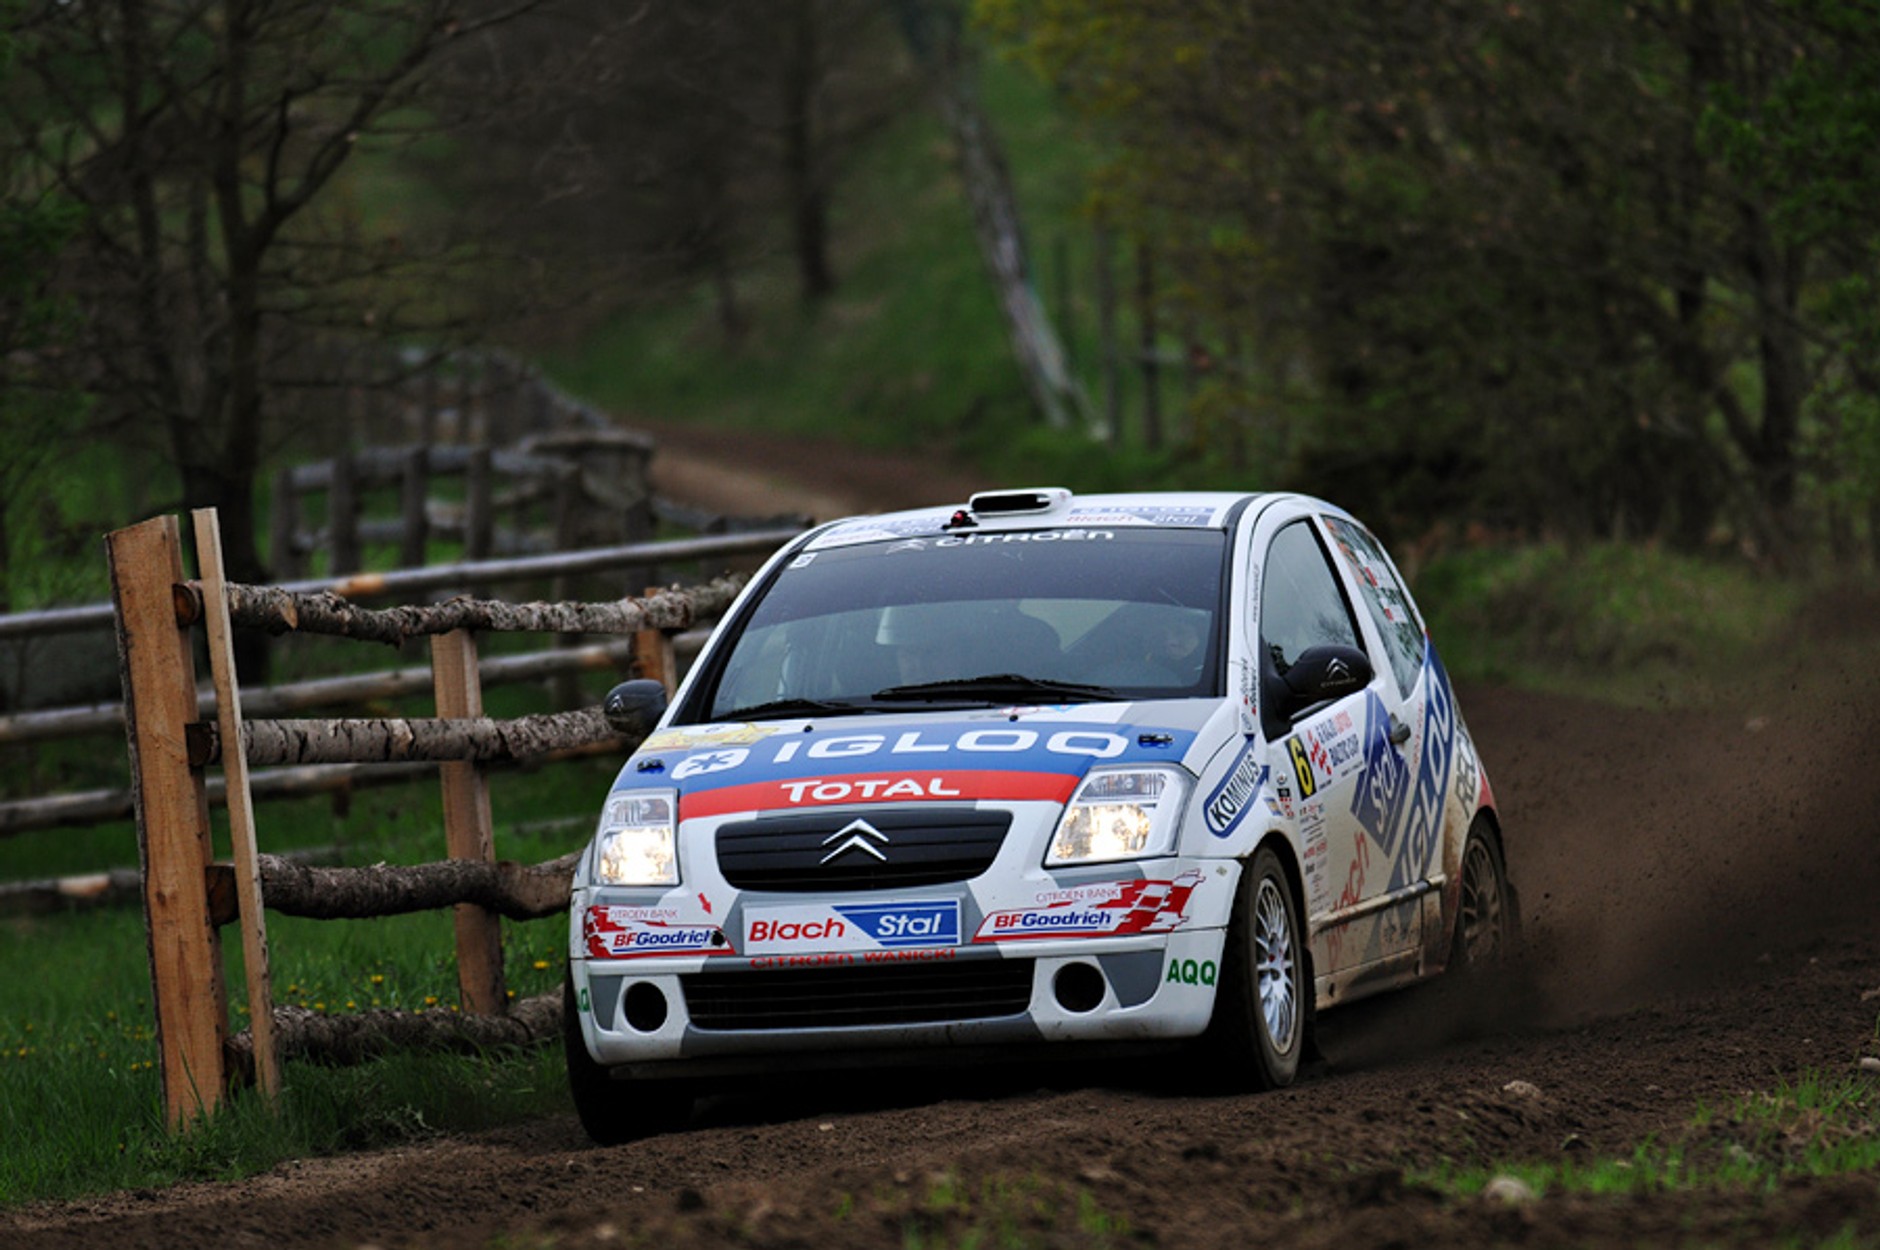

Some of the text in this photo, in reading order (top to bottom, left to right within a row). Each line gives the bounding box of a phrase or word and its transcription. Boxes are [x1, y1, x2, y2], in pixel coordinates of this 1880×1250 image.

[1289, 737, 1314, 796] 6
[780, 777, 961, 804] TOTAL
[1209, 753, 1261, 829] KOMINUS
[1086, 887, 1120, 899] BANK
[748, 912, 943, 942] Blach Stal
[993, 909, 1112, 929] BFGoodrich
[862, 948, 956, 964] WANICKI
[1166, 957, 1218, 987] AQQ
